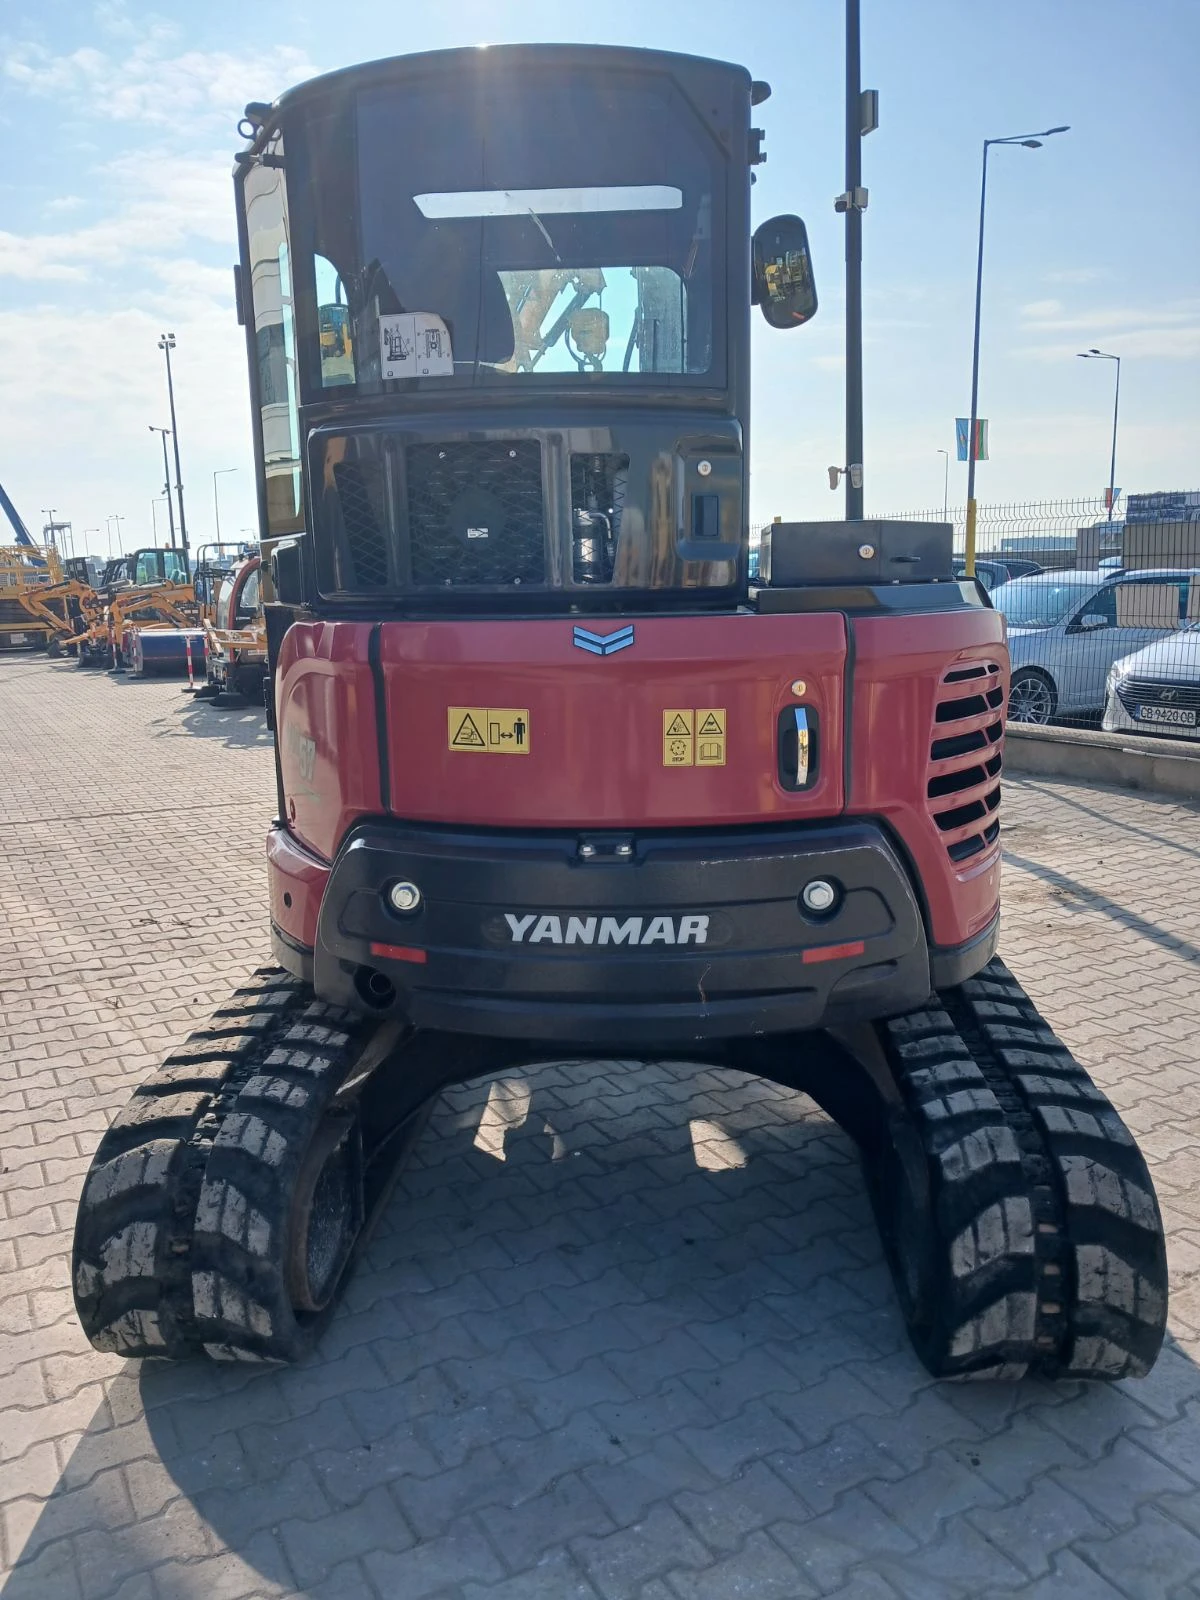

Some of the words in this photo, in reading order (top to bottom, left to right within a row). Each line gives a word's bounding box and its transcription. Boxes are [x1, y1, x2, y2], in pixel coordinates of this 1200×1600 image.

[1140, 706, 1153, 719] CB
[1155, 708, 1179, 722] 9420
[504, 913, 710, 945] YANMAR
